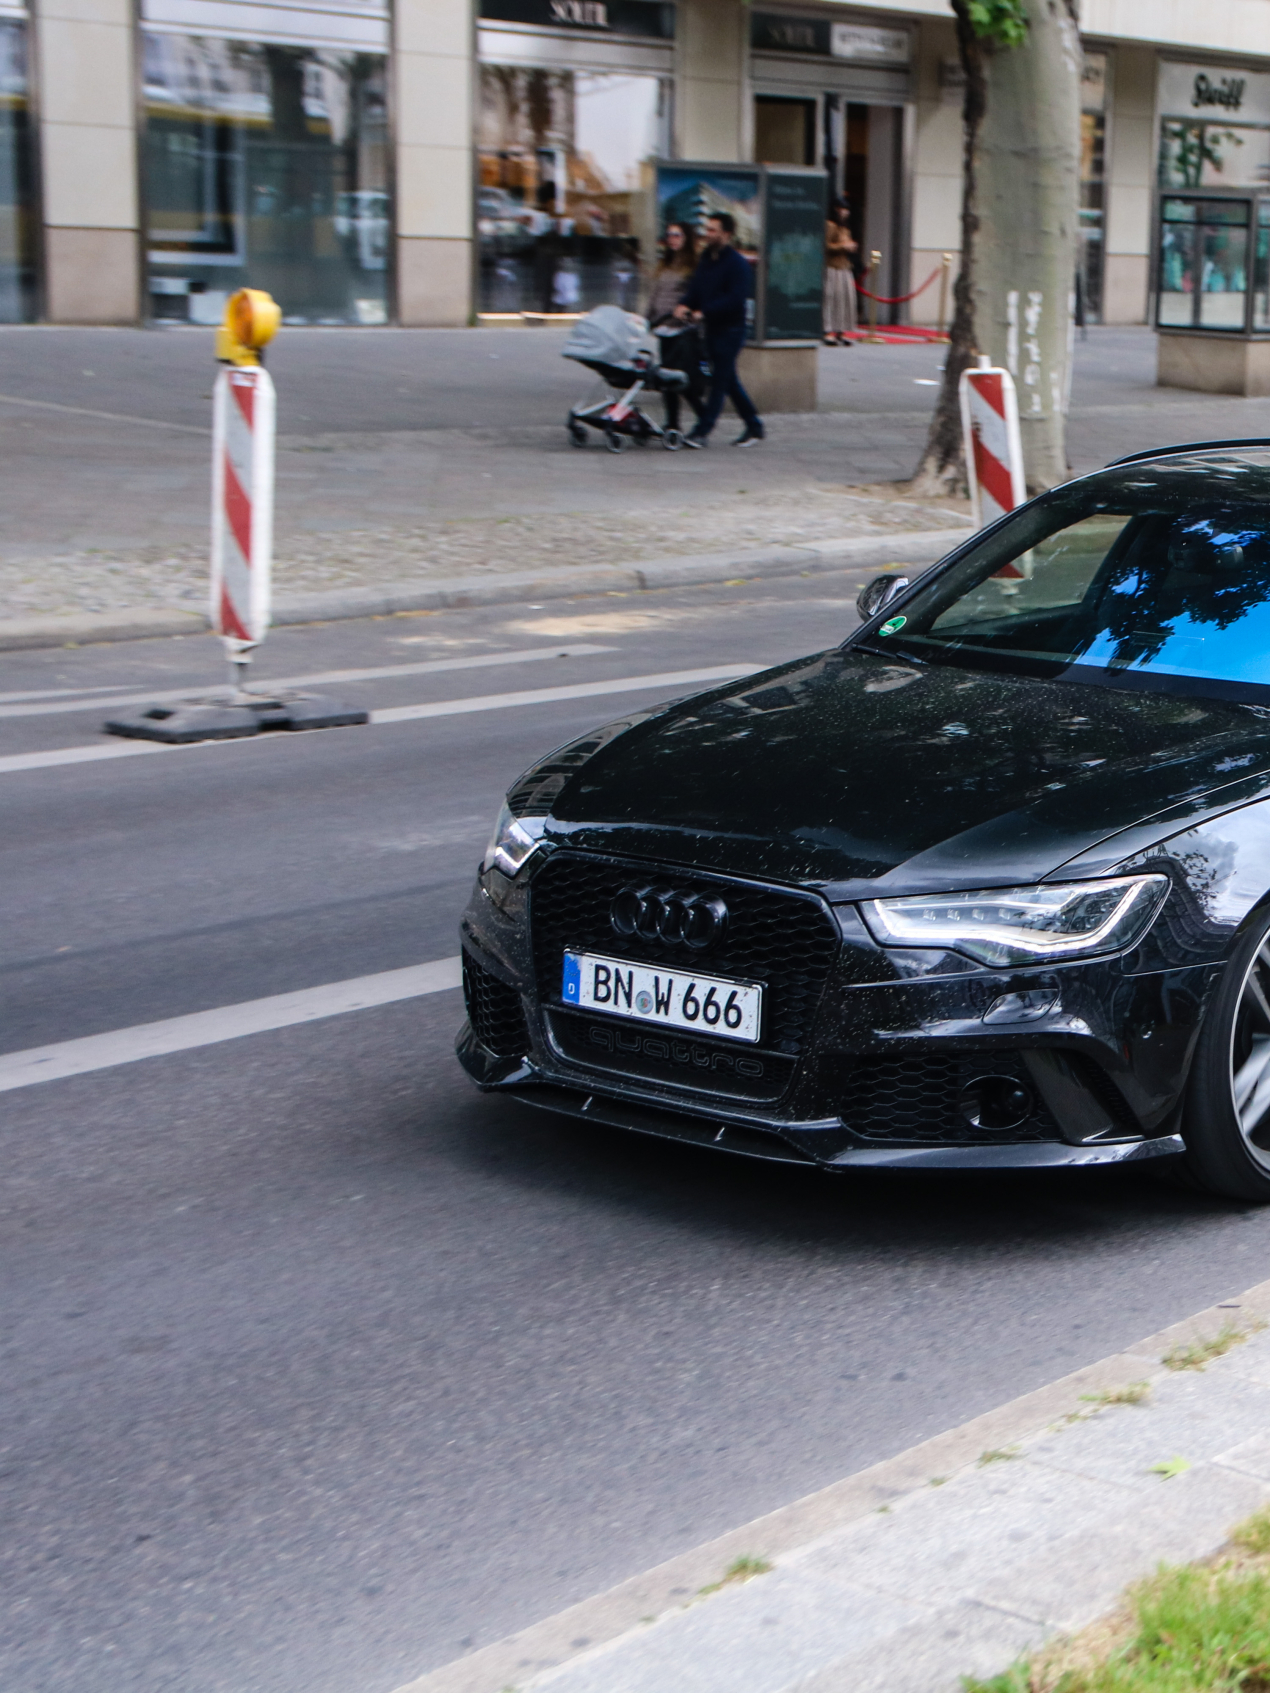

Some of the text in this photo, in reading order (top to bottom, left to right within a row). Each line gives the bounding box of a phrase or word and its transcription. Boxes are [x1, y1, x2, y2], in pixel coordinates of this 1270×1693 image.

[594, 964, 743, 1029] BN W 666
[589, 1026, 764, 1078] quattro
